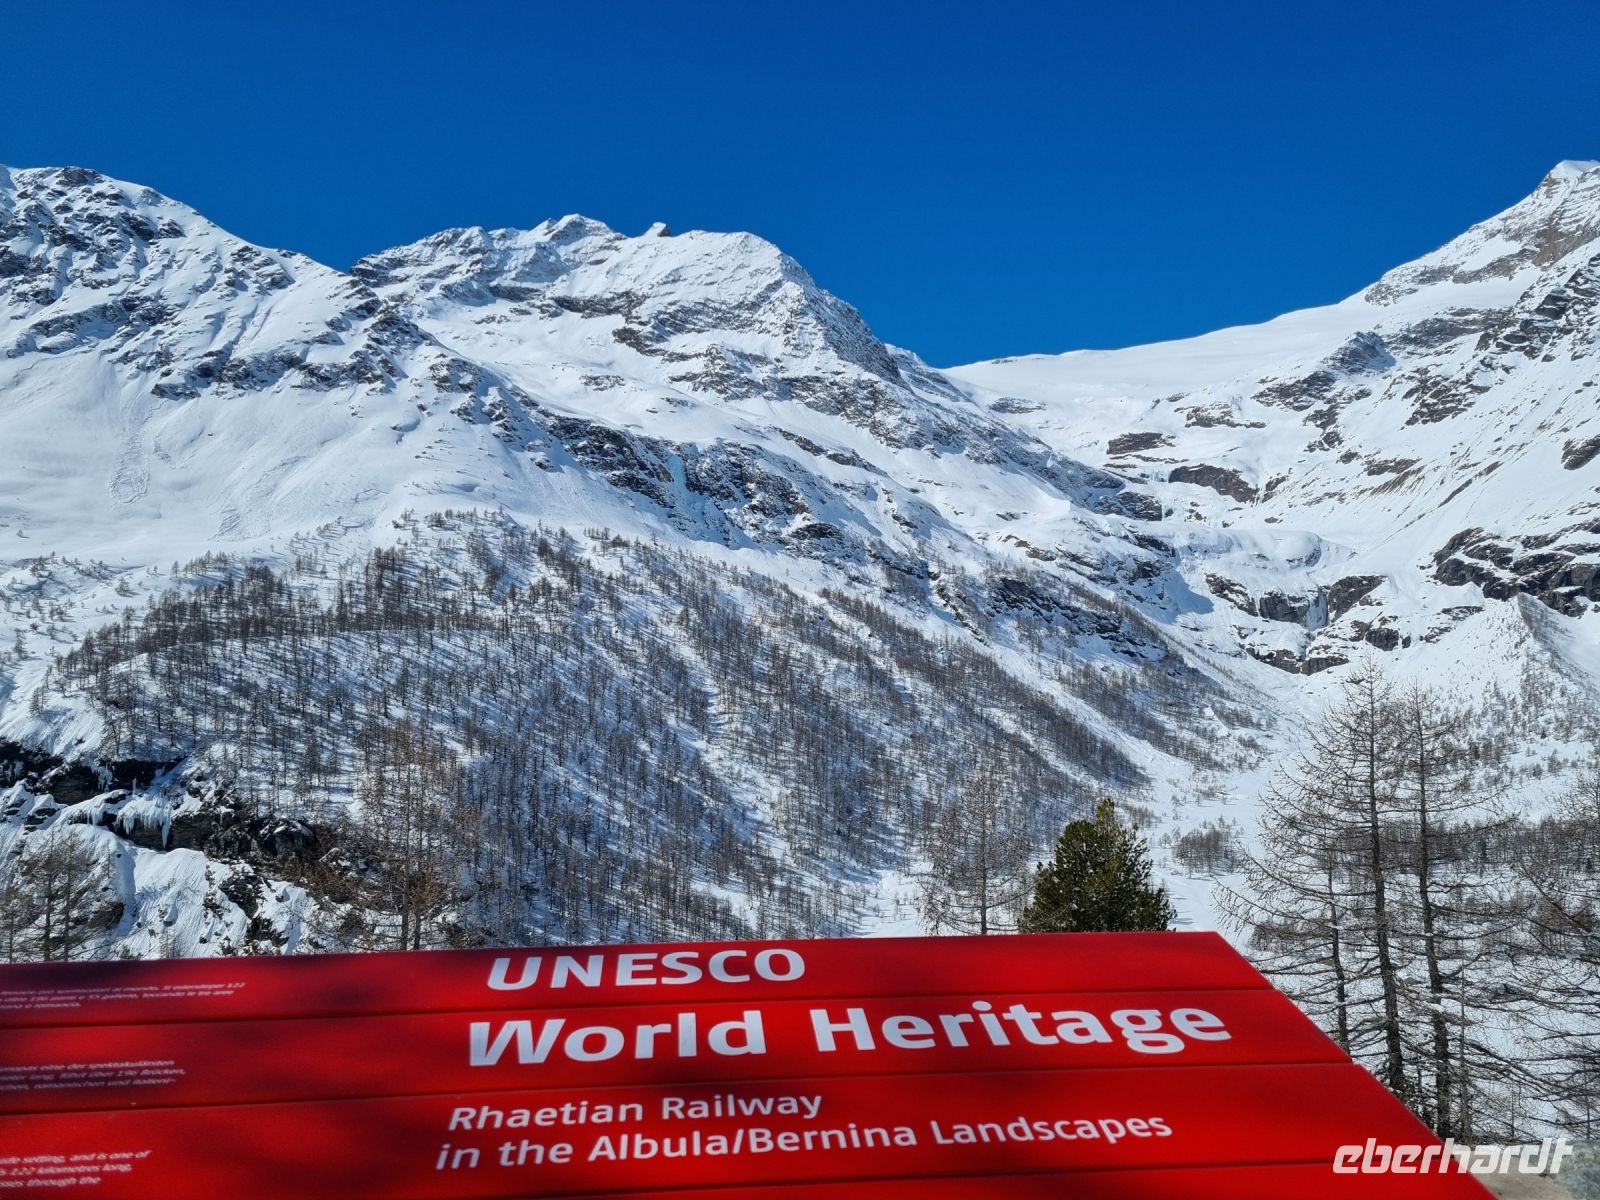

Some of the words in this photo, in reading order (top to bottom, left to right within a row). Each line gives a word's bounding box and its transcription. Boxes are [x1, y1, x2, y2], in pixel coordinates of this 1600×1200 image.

[487, 949, 806, 990] UNESCO
[470, 1010, 767, 1066] World
[810, 1001, 1232, 1054] Heritage
[449, 1101, 643, 1130] Rhaetian
[662, 1095, 822, 1120] Railway
[437, 1144, 480, 1169] in
[499, 1140, 574, 1166] the
[588, 1123, 918, 1161] Albula/Bernina
[931, 1117, 1173, 1145] Landscapes
